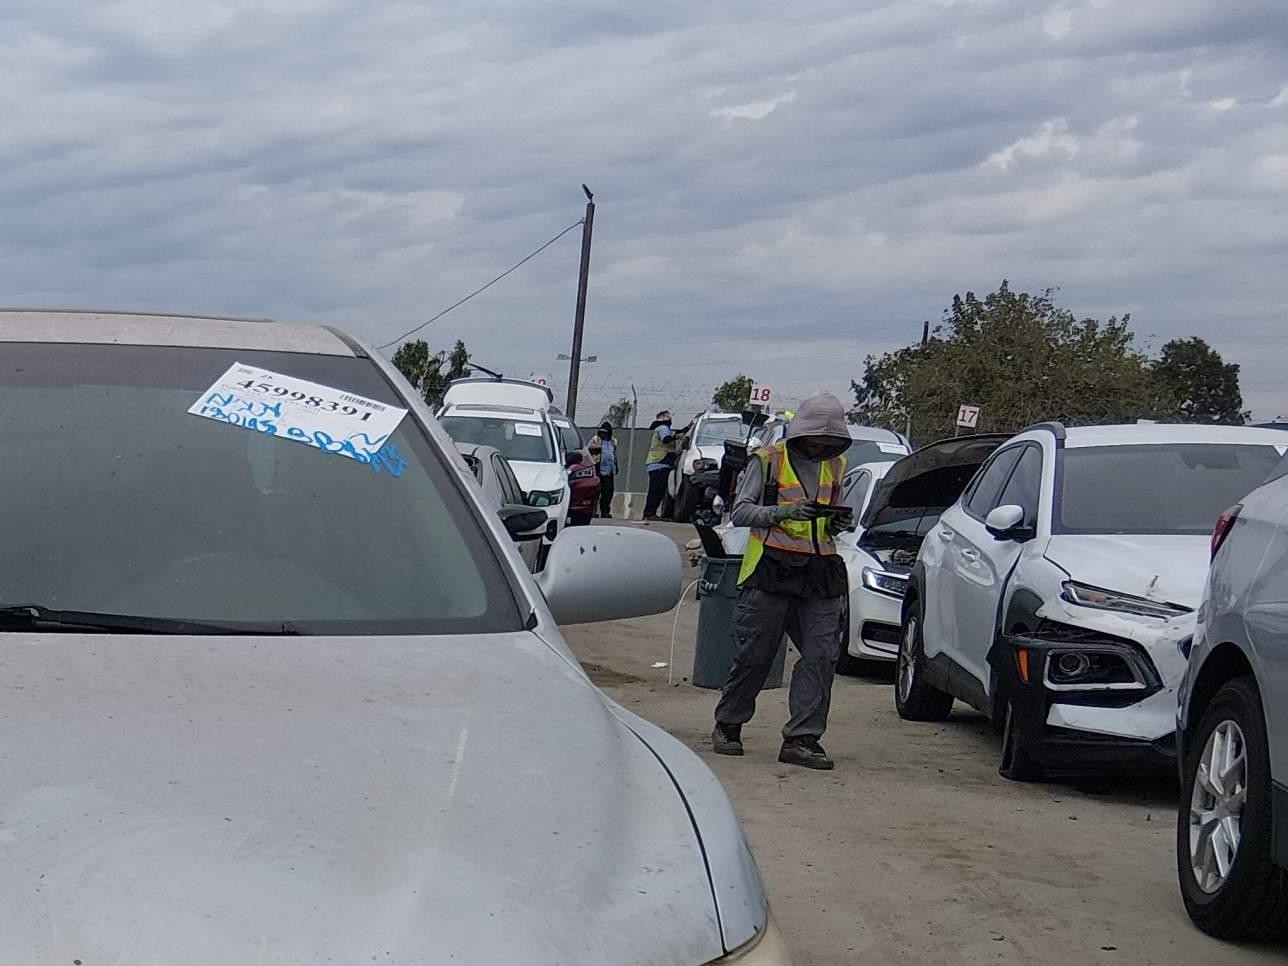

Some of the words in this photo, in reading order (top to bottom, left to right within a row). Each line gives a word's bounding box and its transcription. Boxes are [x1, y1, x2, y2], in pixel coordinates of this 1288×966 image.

[237, 380, 372, 421] 45998391
[751, 388, 770, 401] 18
[959, 410, 977, 423] 17
